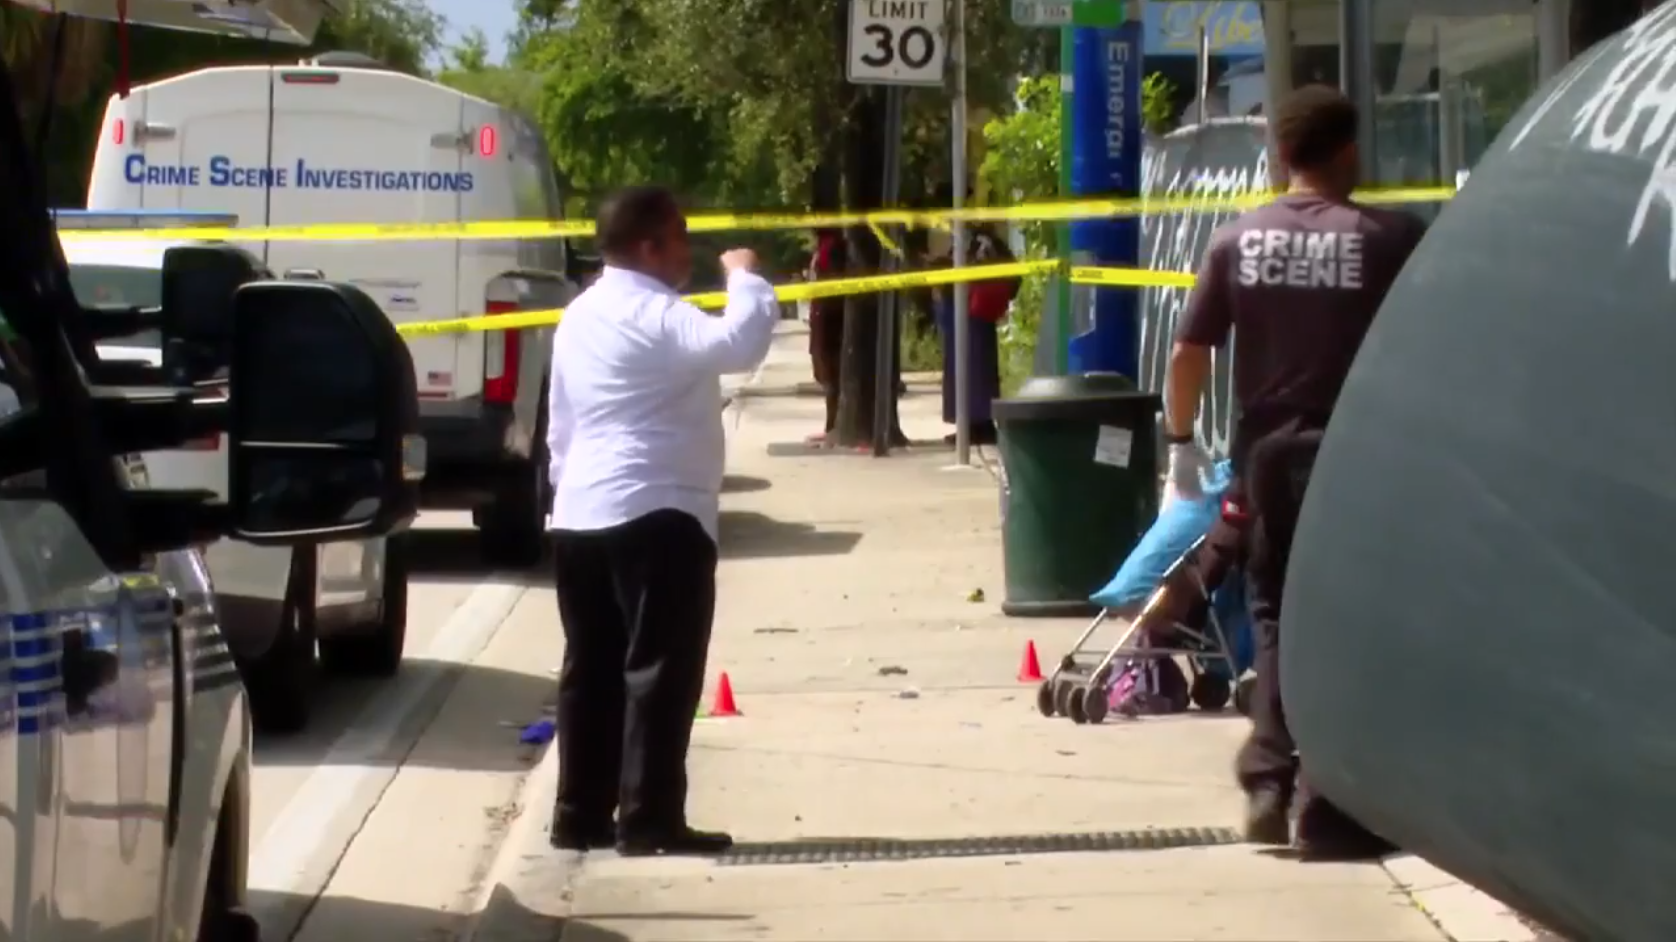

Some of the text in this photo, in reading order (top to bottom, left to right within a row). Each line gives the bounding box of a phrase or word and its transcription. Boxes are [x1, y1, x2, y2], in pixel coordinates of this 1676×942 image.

[868, 0, 928, 19] LIMIT
[860, 23, 935, 69] 30
[1105, 41, 1129, 184] Emerg
[124, 154, 474, 192] CRIME SCENE INVESTIGATIONS
[1238, 228, 1363, 260] CRIME
[1238, 258, 1363, 289] SCENE
